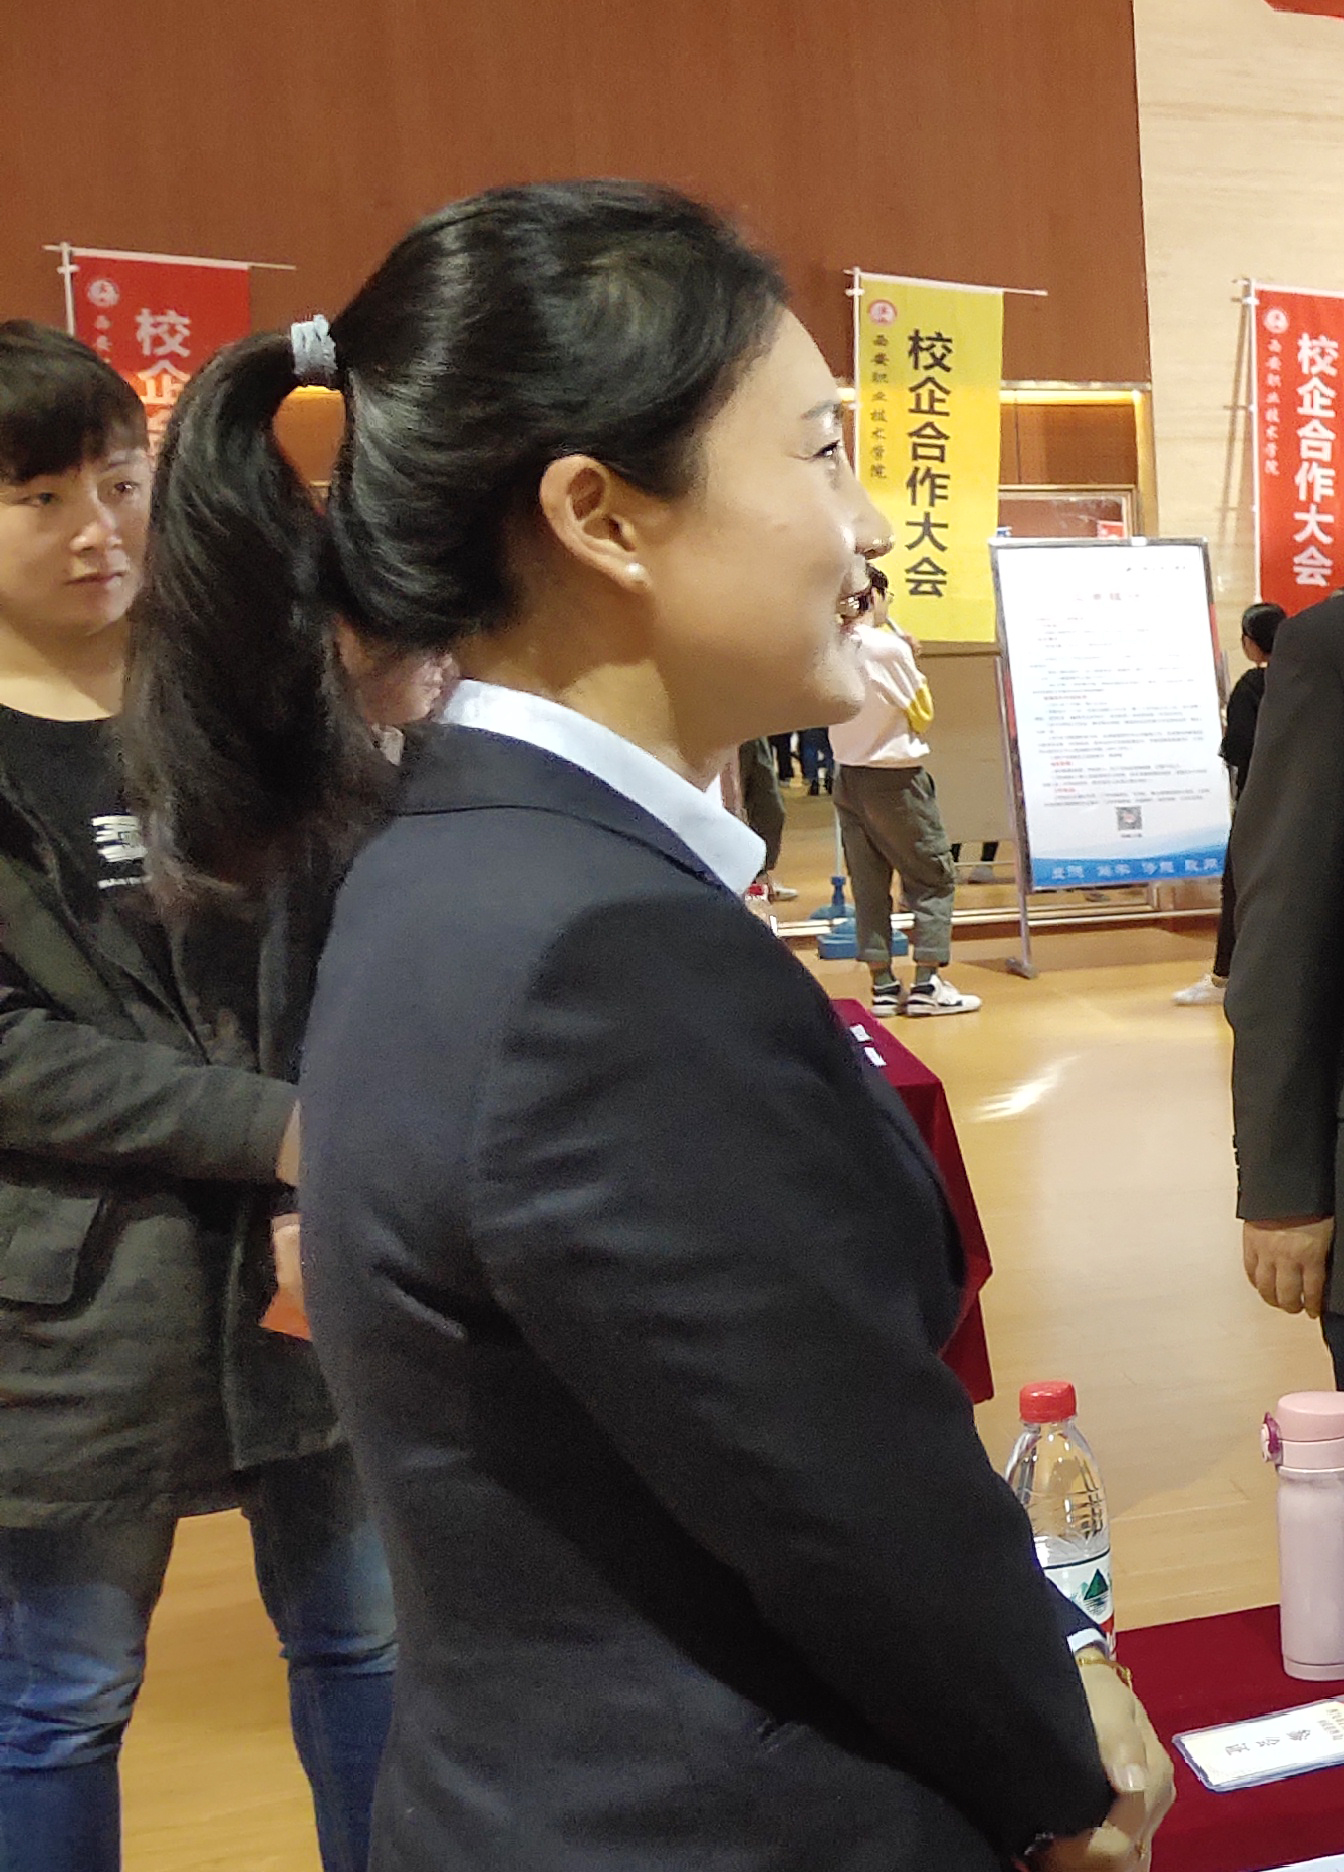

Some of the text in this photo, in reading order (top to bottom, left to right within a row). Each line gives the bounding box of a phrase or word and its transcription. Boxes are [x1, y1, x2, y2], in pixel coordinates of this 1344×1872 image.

[870, 335, 889, 479] 西安职业技术学院
[905, 328, 953, 598] 校企合作大会
[1293, 332, 1338, 587] 校企合作大会
